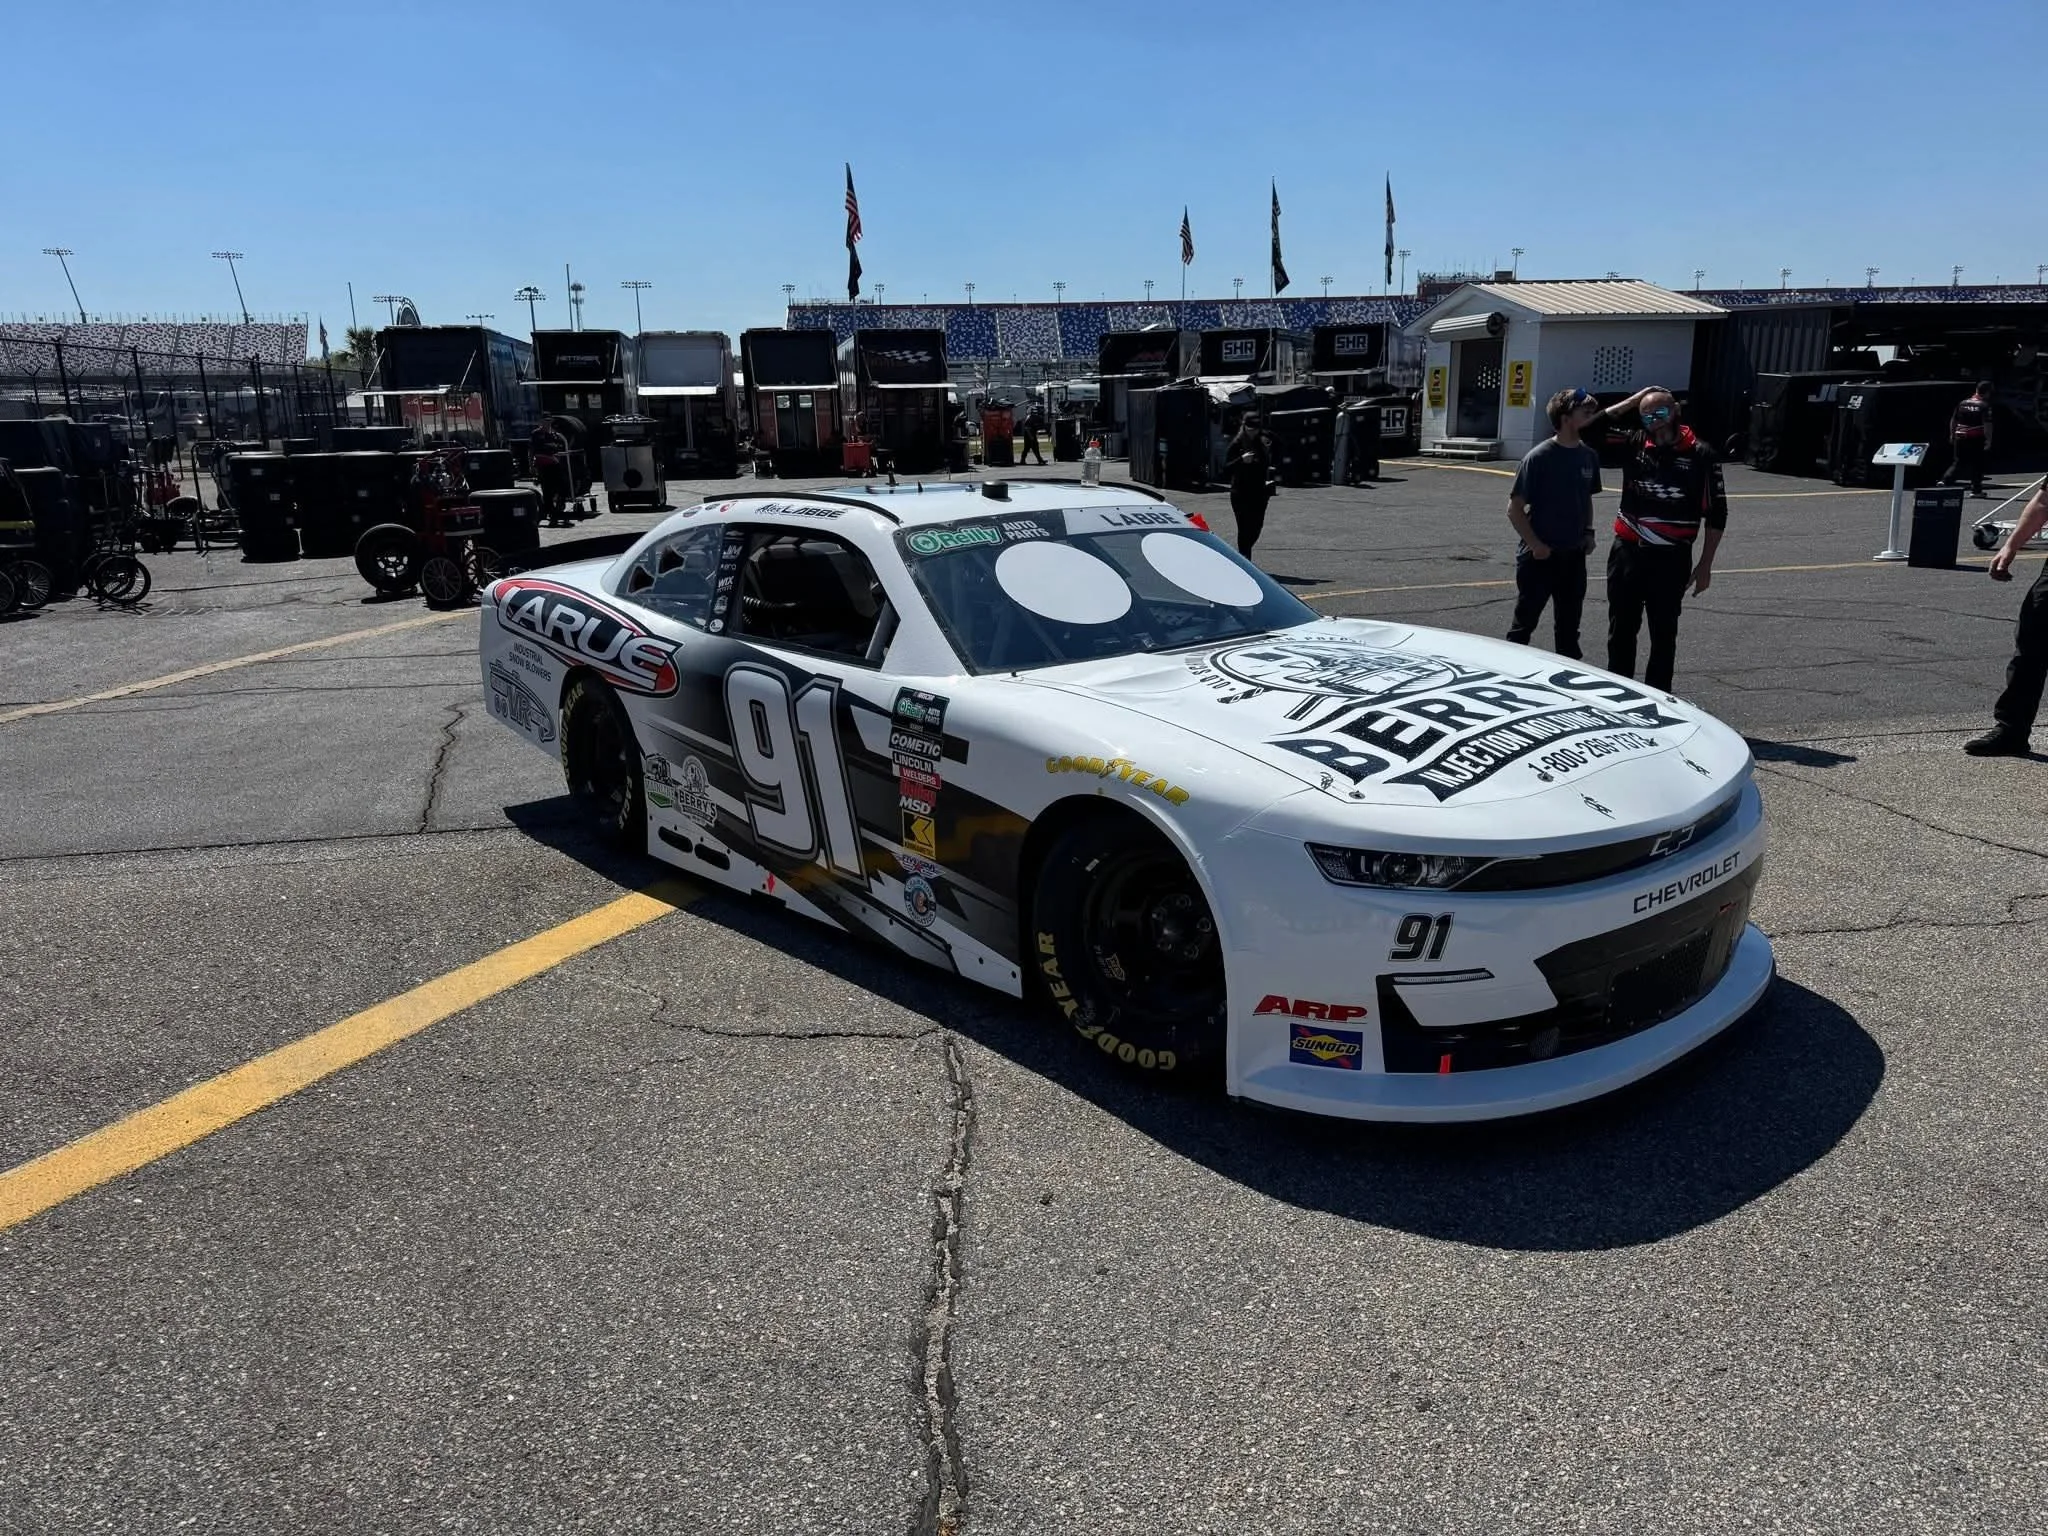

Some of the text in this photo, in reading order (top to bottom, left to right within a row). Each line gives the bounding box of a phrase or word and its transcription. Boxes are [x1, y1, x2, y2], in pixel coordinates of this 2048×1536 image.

[1224, 340, 1254, 356] SHR
[1337, 334, 1367, 350] SHR
[909, 520, 1036, 553] O'Reilly AUTO
[1006, 527, 1050, 540] PARTS
[718, 576, 734, 588] WIX
[499, 585, 678, 690] LARUE
[508, 651, 552, 682] SNOW BLOWERS
[513, 642, 544, 666] INDUSTRIAL
[891, 732, 941, 757] COMETIC
[1418, 727, 1535, 789] INJECTION
[1511, 709, 1607, 741] MOLDING
[893, 752, 934, 773] LINCOLN
[902, 767, 937, 785] WELDERS
[722, 661, 872, 892] 91
[1046, 755, 1190, 807] GOODYEAR
[899, 795, 932, 815] MSD
[1633, 851, 1740, 914] CHEVROLET
[1388, 912, 1455, 962] 91
[1038, 932, 1176, 1070] GOODYEAR
[1253, 994, 1368, 1023] ARP
[1293, 1037, 1360, 1056] SUNOCO
